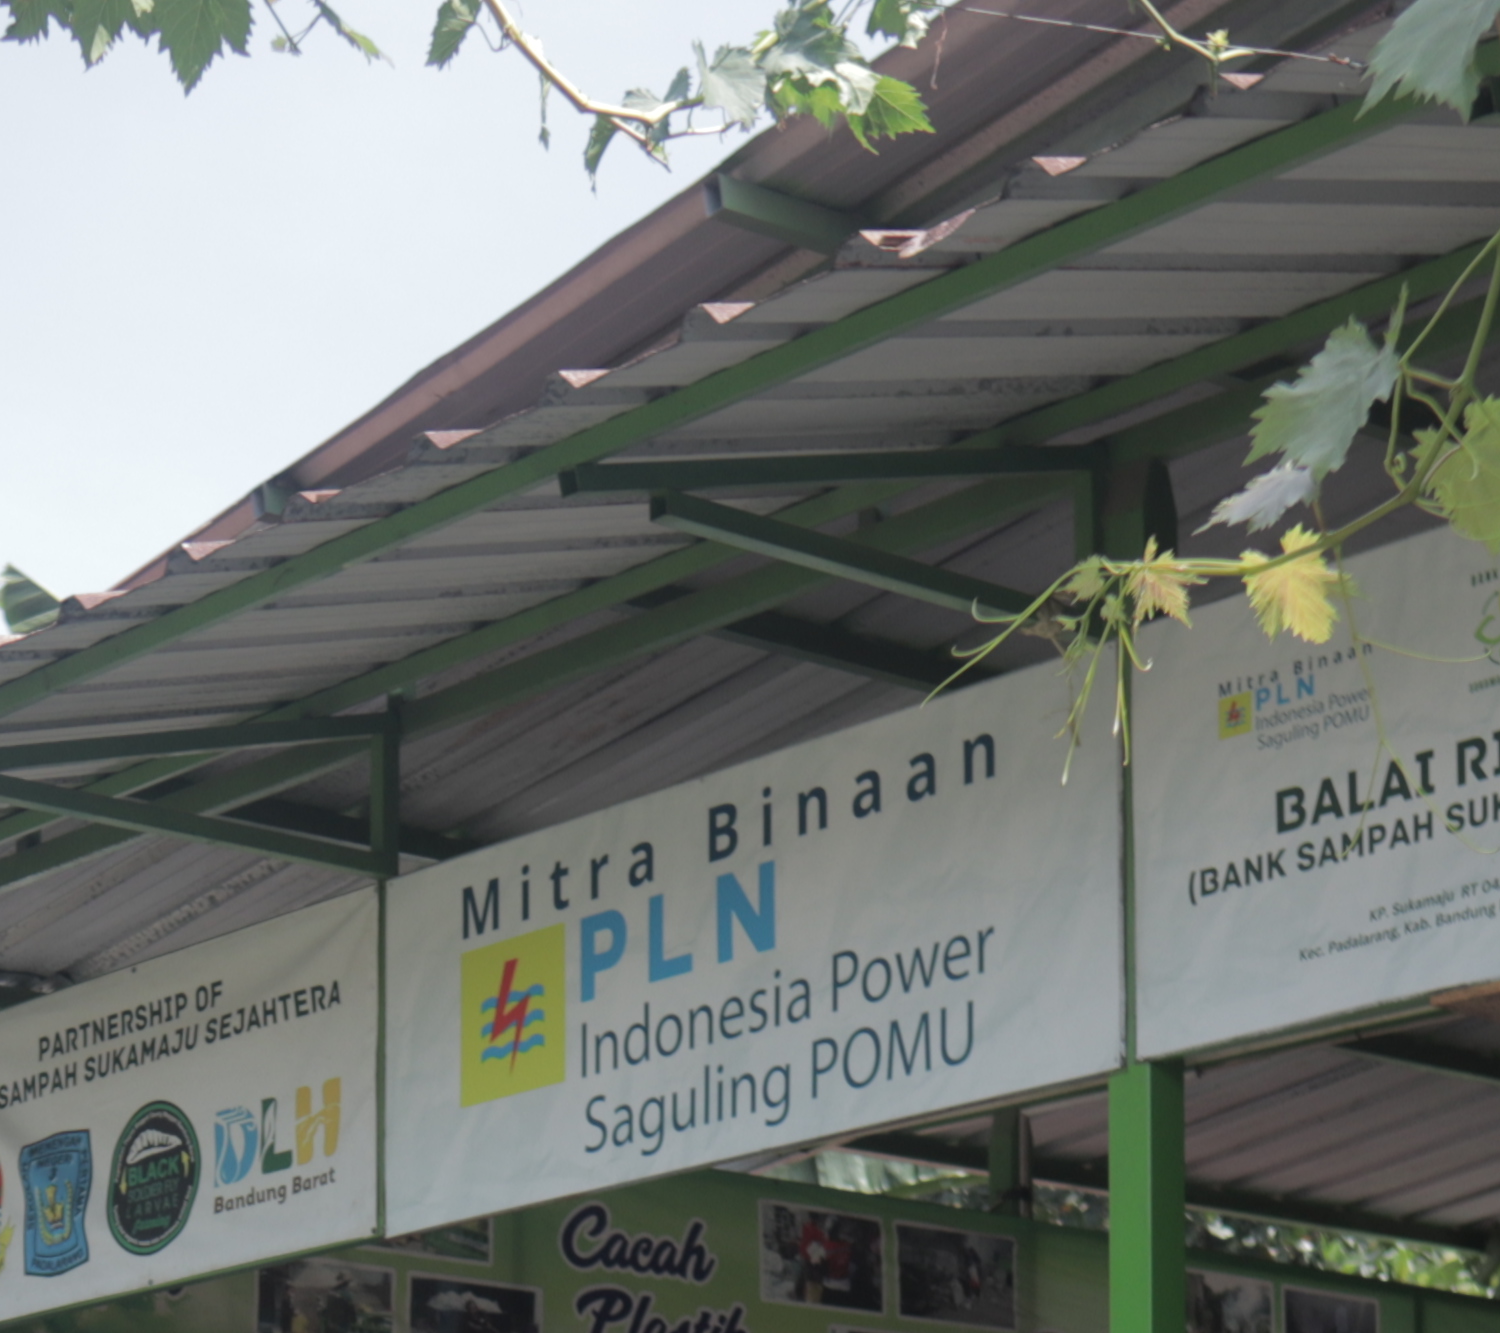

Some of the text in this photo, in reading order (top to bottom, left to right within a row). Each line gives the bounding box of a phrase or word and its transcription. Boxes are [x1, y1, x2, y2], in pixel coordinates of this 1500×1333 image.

[1218, 642, 1374, 698] Mitra Binaan
[1255, 674, 1315, 712] PLN
[1255, 699, 1325, 732] Indonesia
[1256, 705, 1371, 751] Saguling POMU
[1275, 749, 1435, 835] BALAI
[460, 731, 998, 941] Mitra Binaan
[1188, 848, 1287, 906] (BANK
[1296, 810, 1435, 872] SAMPAH
[579, 860, 777, 1004] PLN
[1391, 889, 1455, 917] Sukamaju
[1460, 882, 1480, 899] RT
[1403, 916, 1432, 935] Kab.
[1435, 904, 1497, 930] Bandung
[38, 980, 225, 1063] PARTNERSHIP OF
[83, 1025, 199, 1083] SUKAMAJU
[204, 980, 342, 1045] SEJAHTERA
[580, 925, 995, 1079] Indonesia Power
[584, 1000, 976, 1157] Saguling POMU
[128, 1154, 180, 1187] BLACK
[213, 1076, 342, 1189] DLH
[213, 1168, 336, 1215] Bandung Barat
[559, 1202, 718, 1285] Cacah
